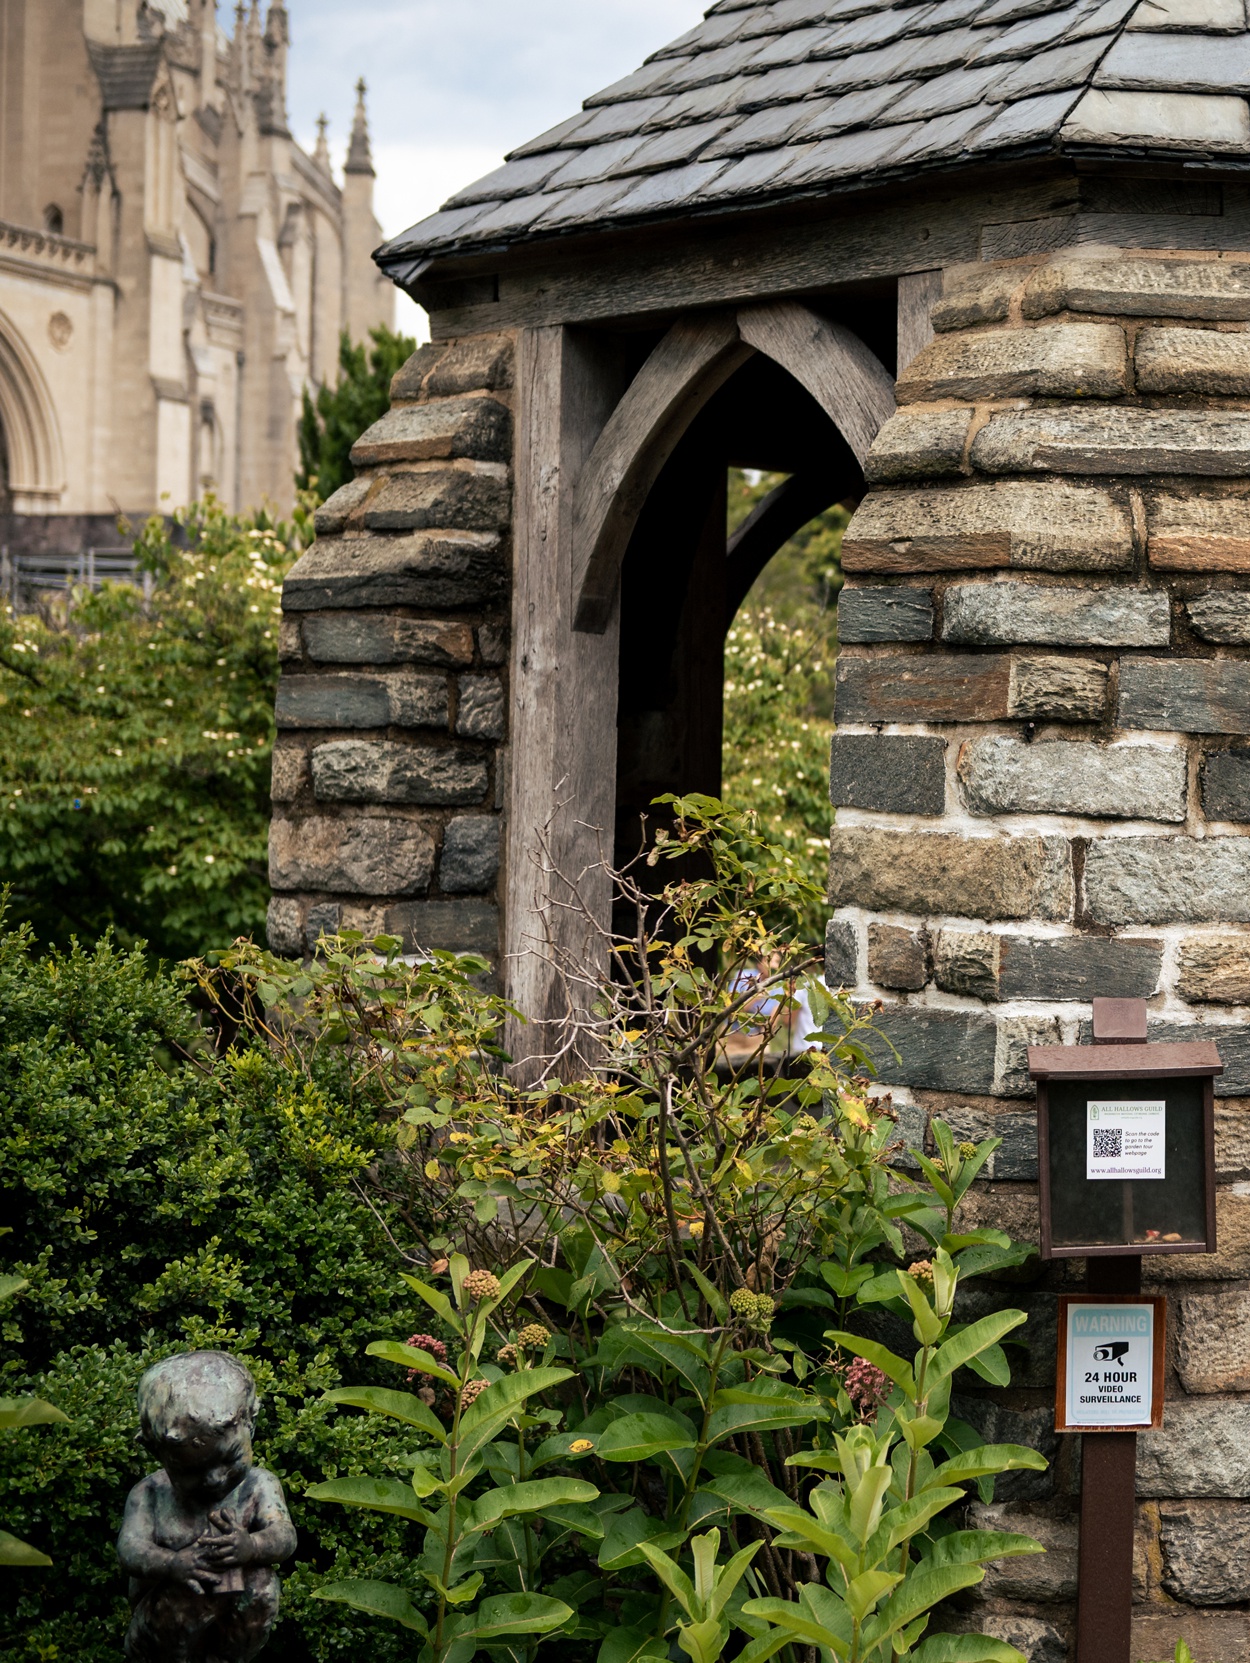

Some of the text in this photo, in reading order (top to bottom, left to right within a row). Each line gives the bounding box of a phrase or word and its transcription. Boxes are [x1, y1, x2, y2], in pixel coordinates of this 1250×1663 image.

[1075, 1316, 1147, 1332] WARNING
[1084, 1372, 1137, 1383] 24 HOUR
[1098, 1385, 1123, 1393] VIDEO
[1080, 1395, 1141, 1403] SURVEILLANCE
